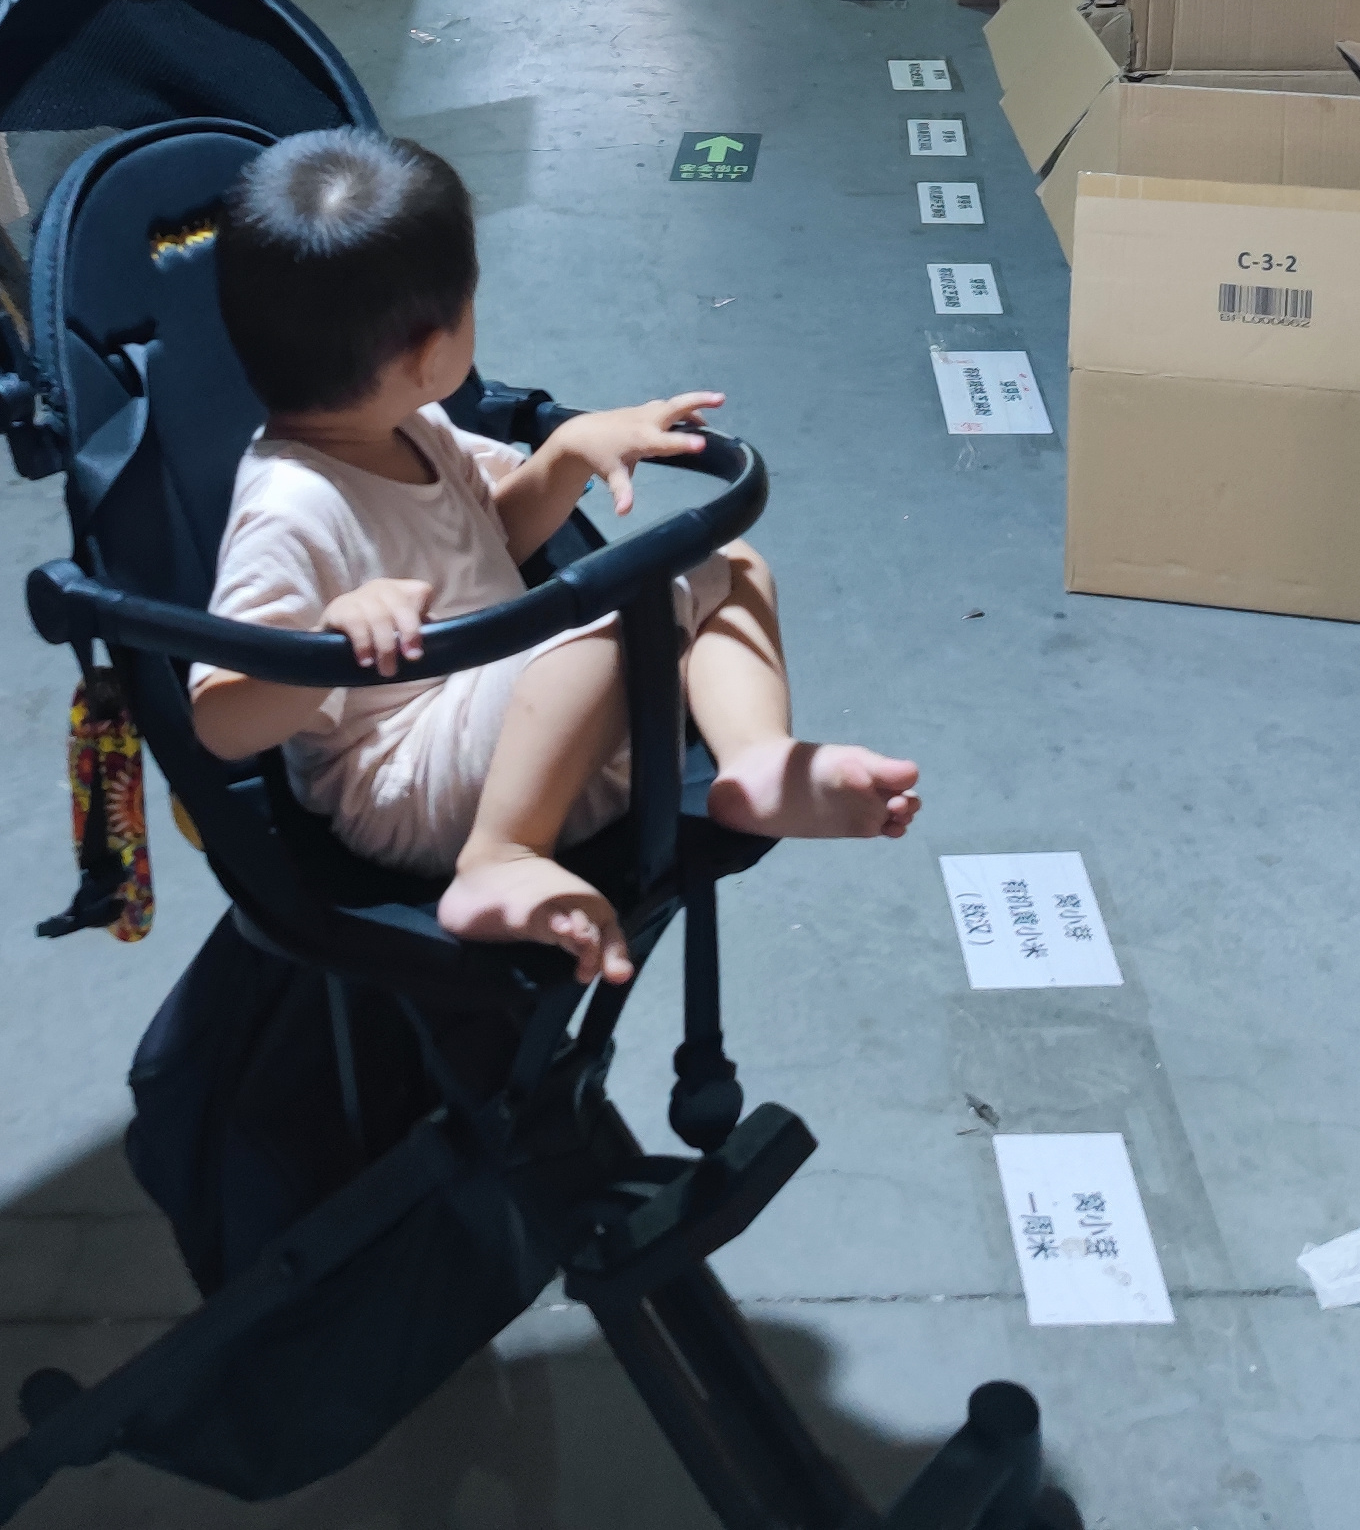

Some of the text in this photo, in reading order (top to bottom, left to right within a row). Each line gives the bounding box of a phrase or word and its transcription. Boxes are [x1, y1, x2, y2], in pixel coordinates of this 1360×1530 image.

[1237, 251, 1299, 273] C-3-2
[1051, 893, 1094, 942] 窝小芽
[1072, 1190, 1120, 1259] 窝小芽
